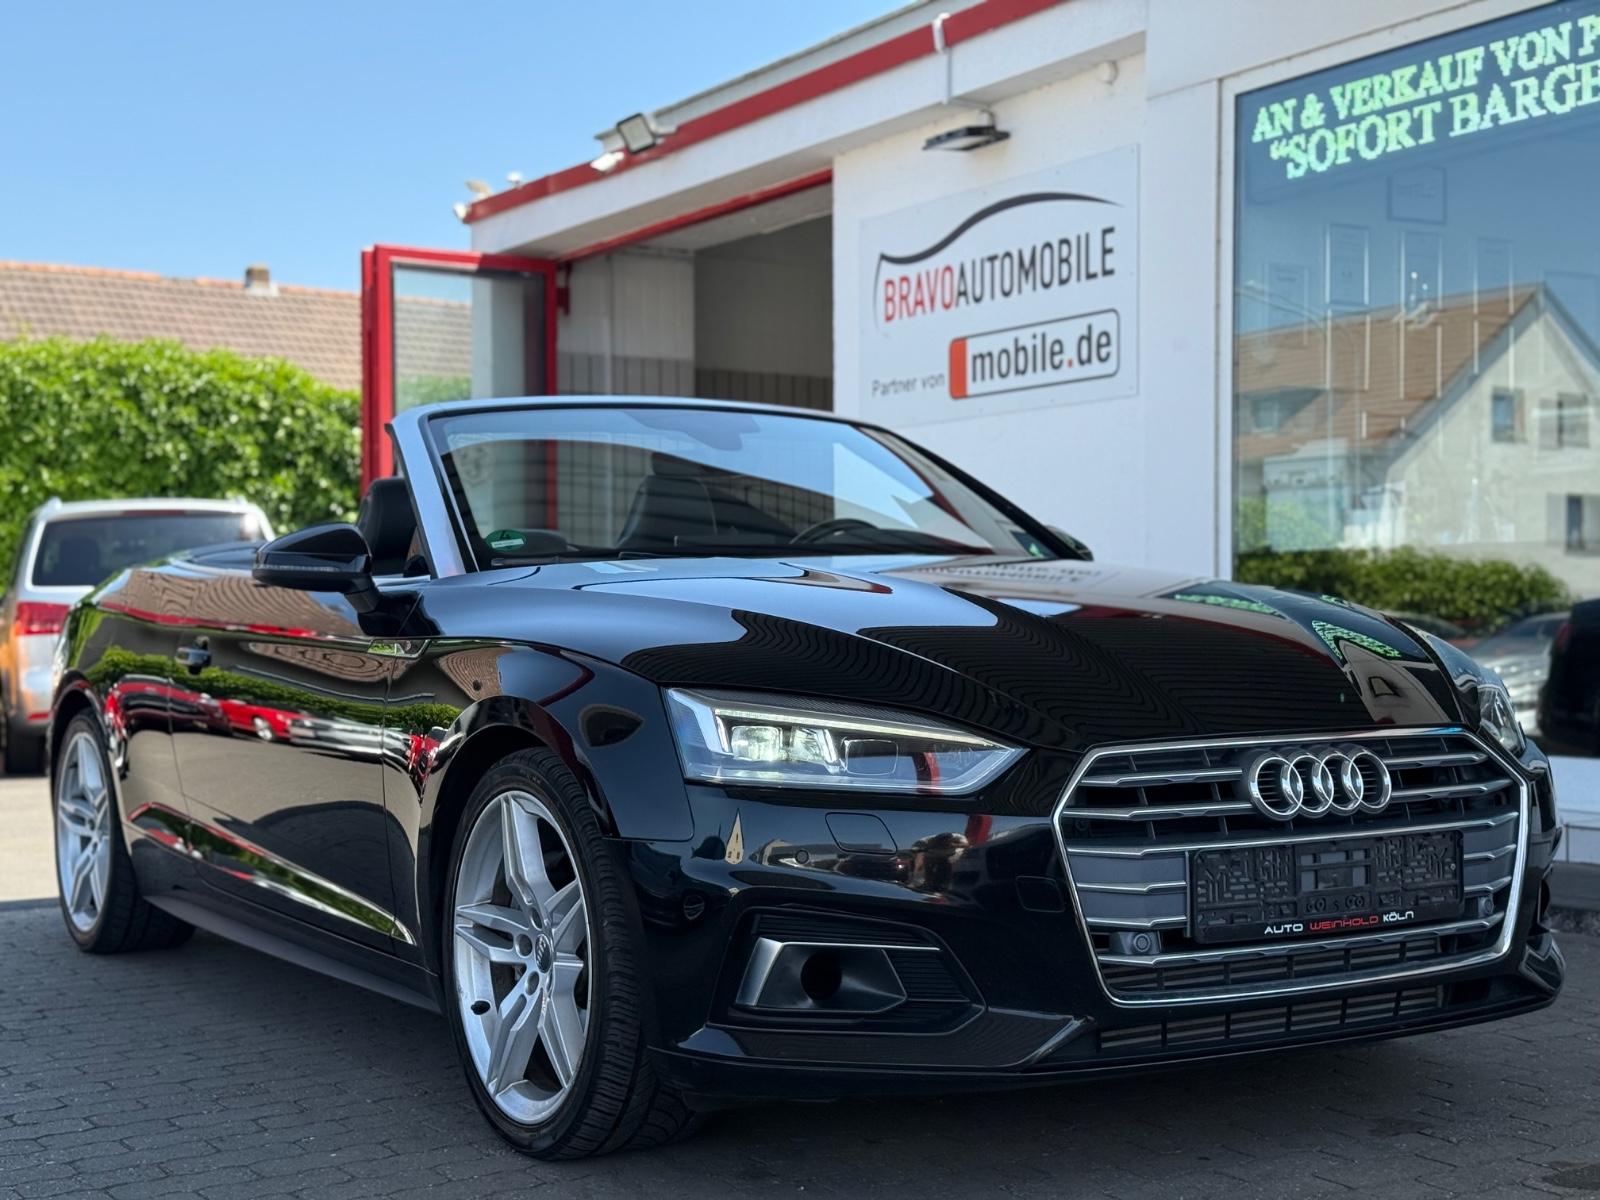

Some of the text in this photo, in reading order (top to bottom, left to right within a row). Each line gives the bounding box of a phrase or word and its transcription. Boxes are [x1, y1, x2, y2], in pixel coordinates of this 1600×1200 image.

[1252, 98, 1296, 142] AN
[1300, 92, 1326, 129] &
[1330, 46, 1485, 120] VERKAUF
[1489, 21, 1572, 76] VON
[884, 226, 1116, 323] BRAVOAUTOMOBILE
[971, 324, 1112, 383] mobile.de
[872, 372, 945, 398] Partner von
[1264, 911, 1414, 935] AUTO WEINHOLD KÖLN
